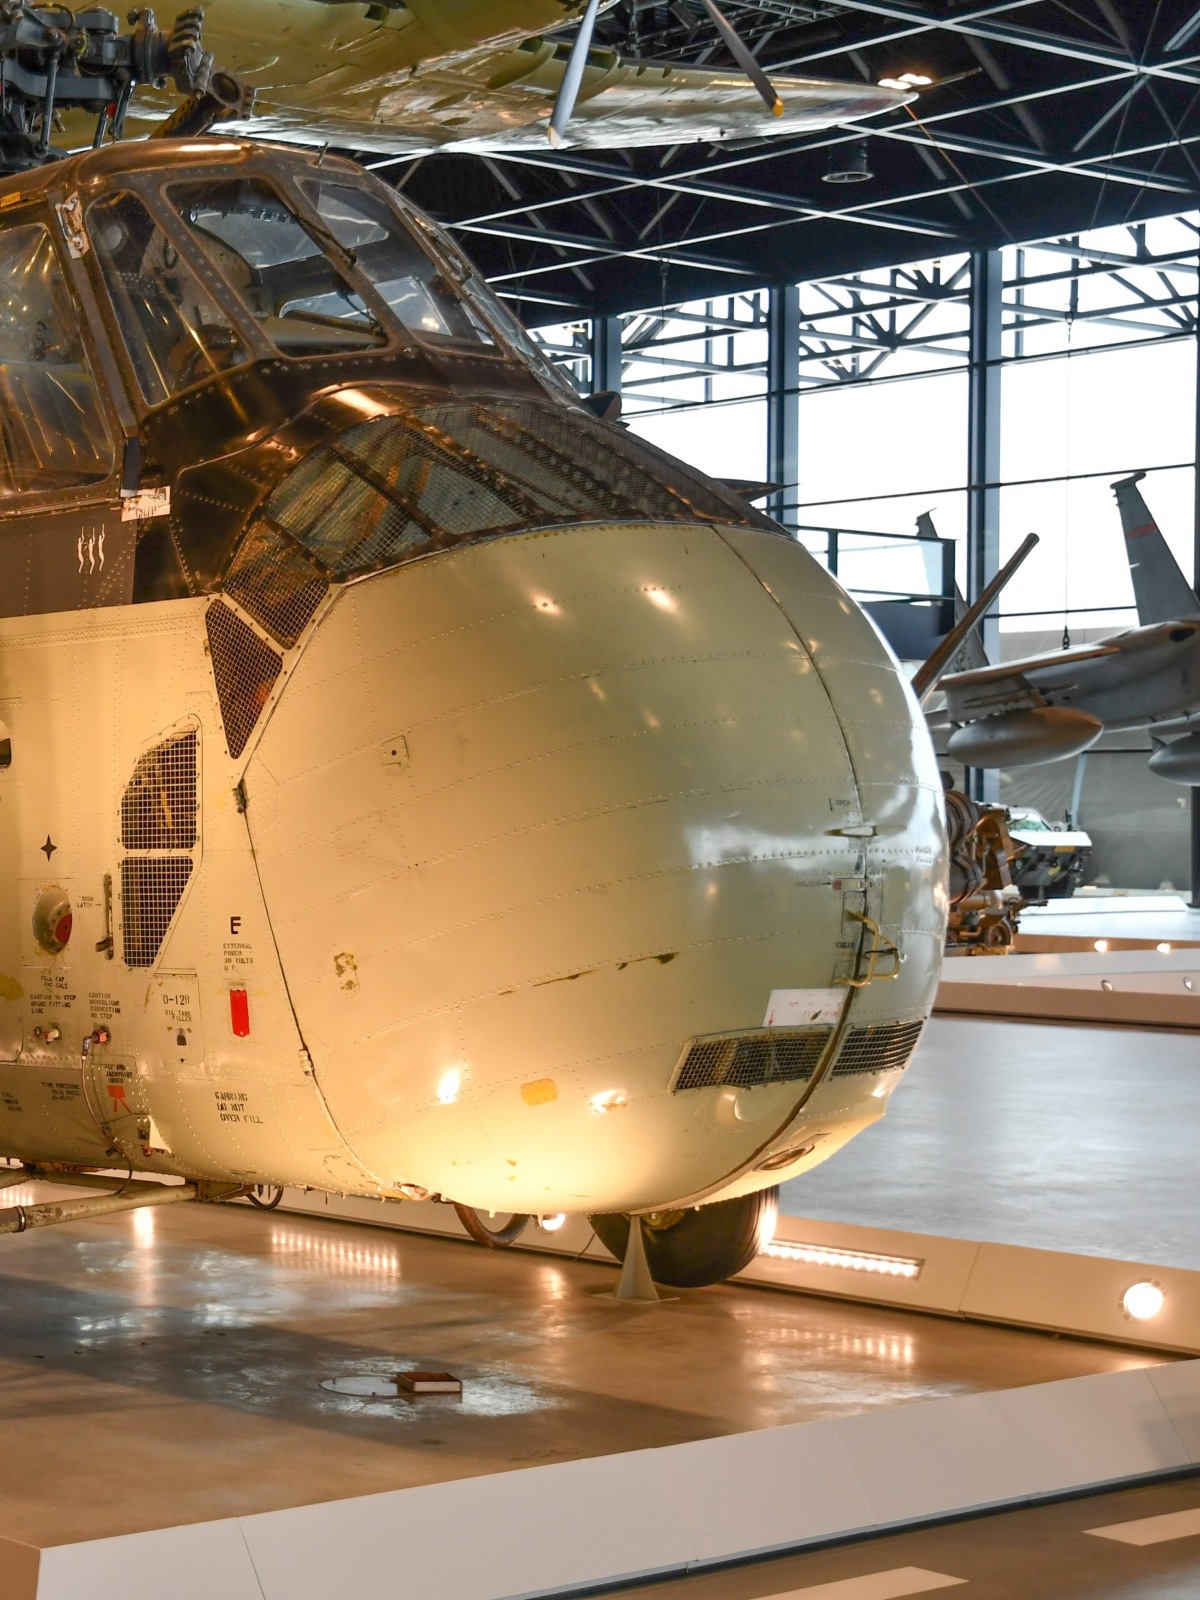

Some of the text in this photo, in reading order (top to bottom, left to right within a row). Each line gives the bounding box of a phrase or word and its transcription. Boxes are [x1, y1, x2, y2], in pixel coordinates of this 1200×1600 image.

[230, 916, 242, 935] E
[223, 942, 253, 950] EXTERNAL
[235, 957, 254, 965] VOLTS
[88, 992, 111, 1000] CAUTION
[99, 1012, 113, 1020] STEP
[164, 1009, 176, 1017] OIL
[214, 1091, 248, 1102] WARNING
[230, 1103, 245, 1112] NOT
[219, 1113, 264, 1125] OVER FILL
